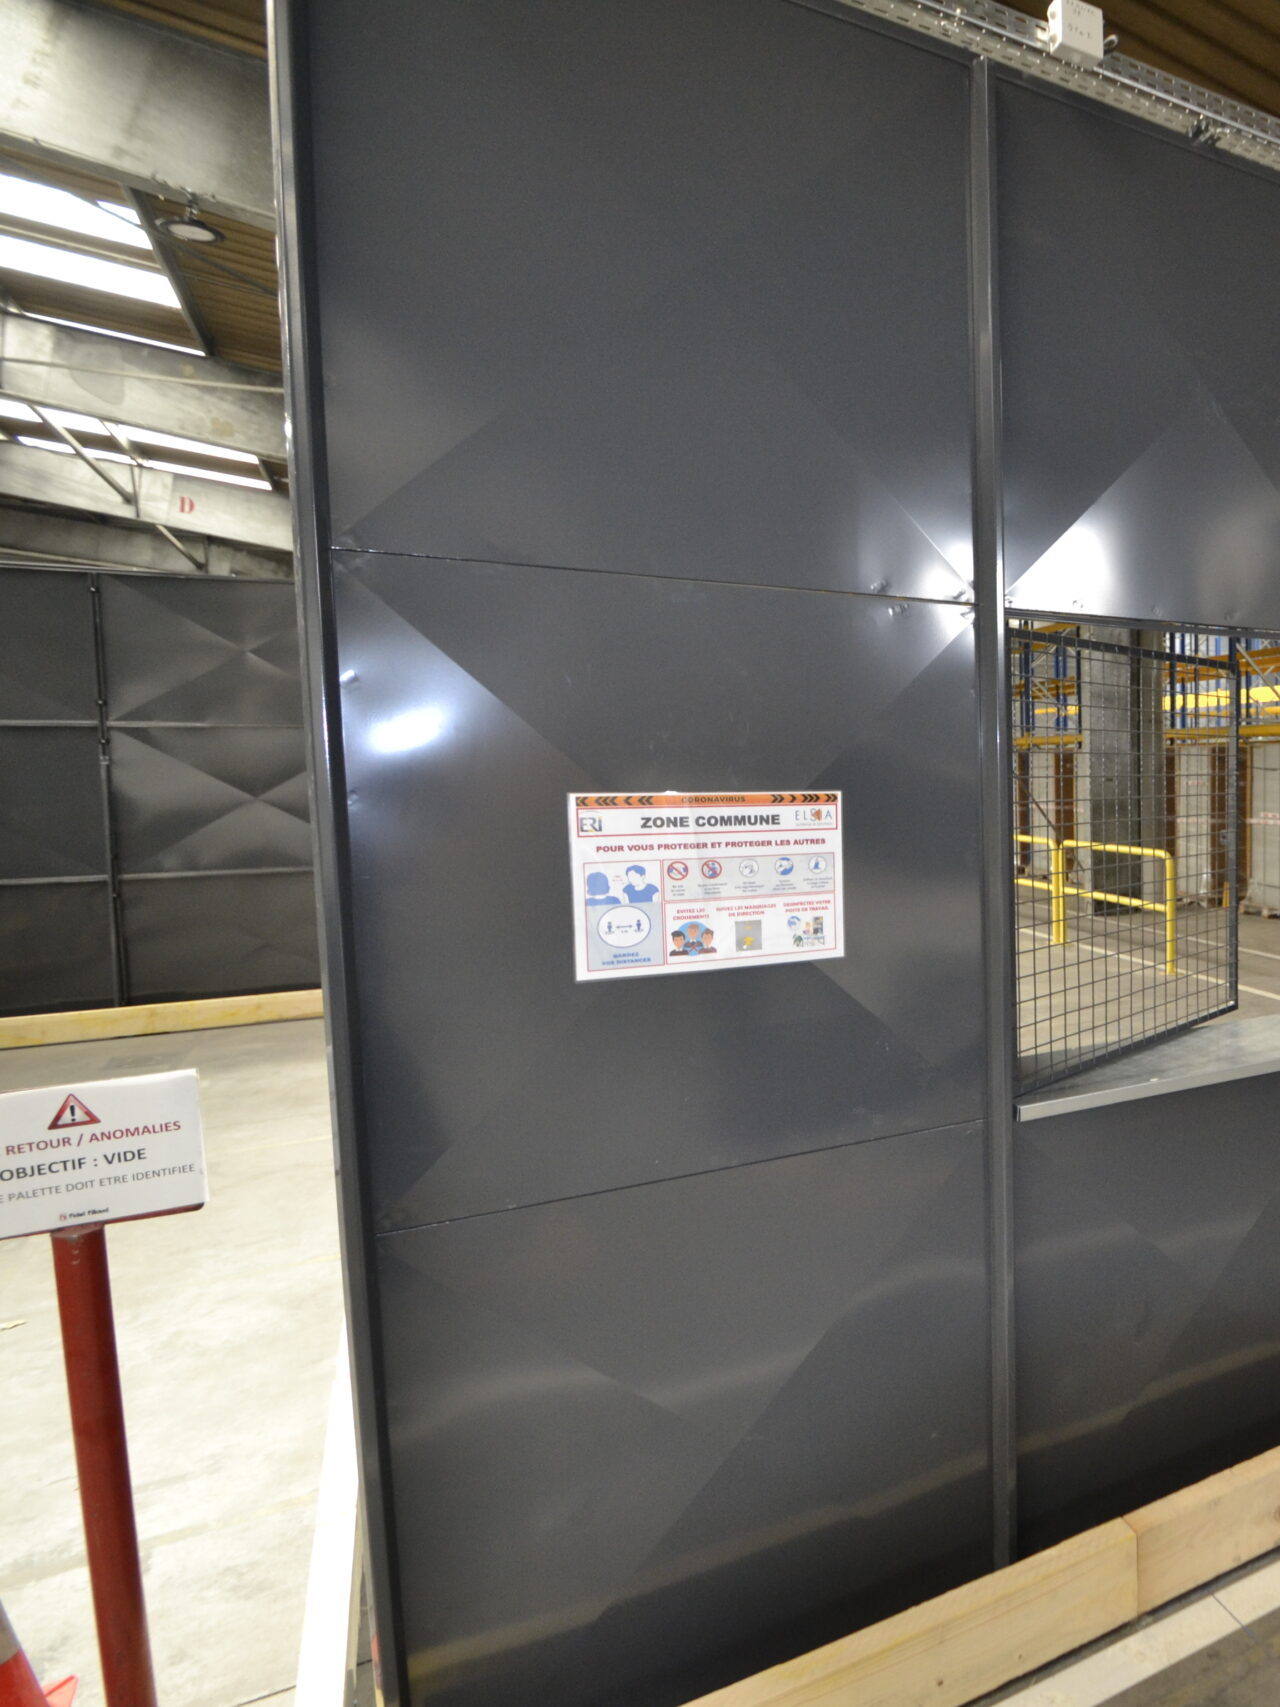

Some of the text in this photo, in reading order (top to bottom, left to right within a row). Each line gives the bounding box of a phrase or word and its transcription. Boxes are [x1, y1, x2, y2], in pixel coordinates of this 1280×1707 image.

[681, 795, 746, 804] CORONAVIRUS
[640, 814, 781, 829] ZONE COMMUNE
[596, 844, 624, 853] POUR
[627, 844, 654, 852] VOUS
[657, 842, 708, 851] PROTEGER
[711, 841, 722, 849] ET
[725, 840, 772, 848] PROTEGER
[793, 838, 826, 846] AUTRES
[5, 1136, 73, 1156] RETOUR
[88, 1120, 181, 1143] ANOMALIES
[0, 1157, 87, 1182] OBJECTIF
[103, 1148, 147, 1165] VIDE
[8, 1184, 62, 1203] PALETTE
[65, 1179, 95, 1193] DOIT
[99, 1174, 128, 1187] ETRE
[132, 1163, 195, 1181] IDENTIFIEE
